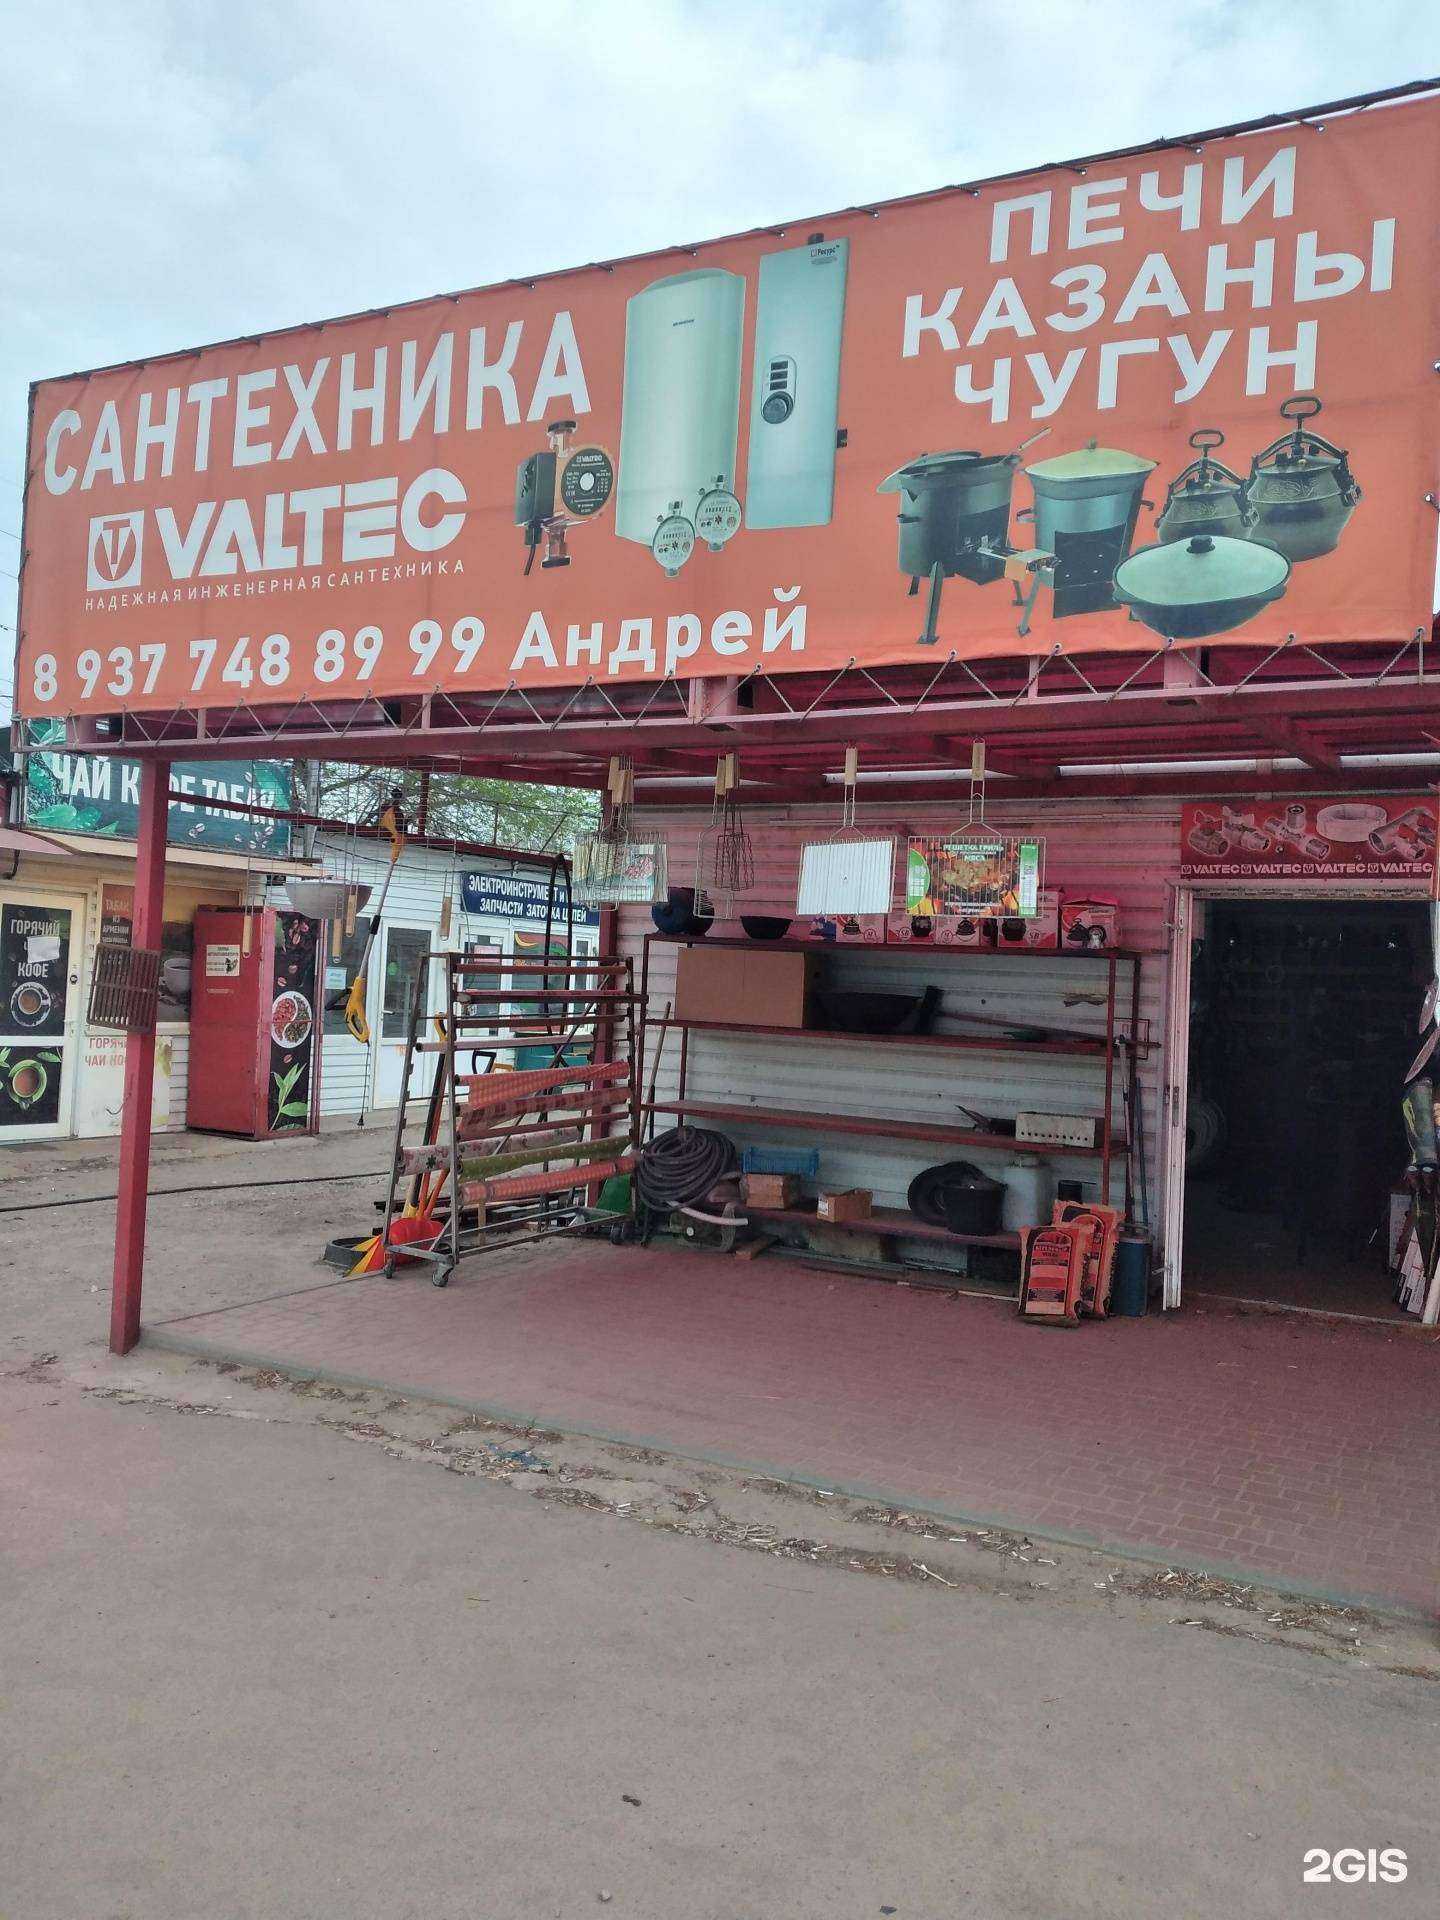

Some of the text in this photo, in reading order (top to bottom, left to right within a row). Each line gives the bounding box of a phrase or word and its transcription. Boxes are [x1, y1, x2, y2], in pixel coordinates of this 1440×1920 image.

[990, 146, 1297, 263] ПЕЧИ
[903, 217, 1395, 358] КАЗАНЫ
[954, 320, 1318, 423] ЧУГУН
[44, 311, 591, 496] САНТЕХНИКА
[154, 468, 468, 579] VALTEC
[85, 559, 465, 612] НАДЕЖНАЯ ИНЖЕНЕРНАЯ САНТЕХНИКА
[33, 616, 486, 701] 8 937 748 89 99
[509, 585, 807, 676] Андрей
[53, 753, 111, 801] ЧАЙ
[121, 764, 196, 813] КЕ
[468, 875, 558, 901] ЭЛЕКТРОИНСТРУМЕТ
[1193, 862, 1433, 874] VALTEC VALTEC VALTEC VALTEC
[10, 919, 61, 936] ГОРЯЧИЙ
[479, 898, 524, 916] ЗАПЧАСТИ
[562, 907, 587, 922] ЦПЕЙ
[18, 962, 49, 978] КОФЕ
[89, 1037, 125, 1049] ГОРЯЧ
